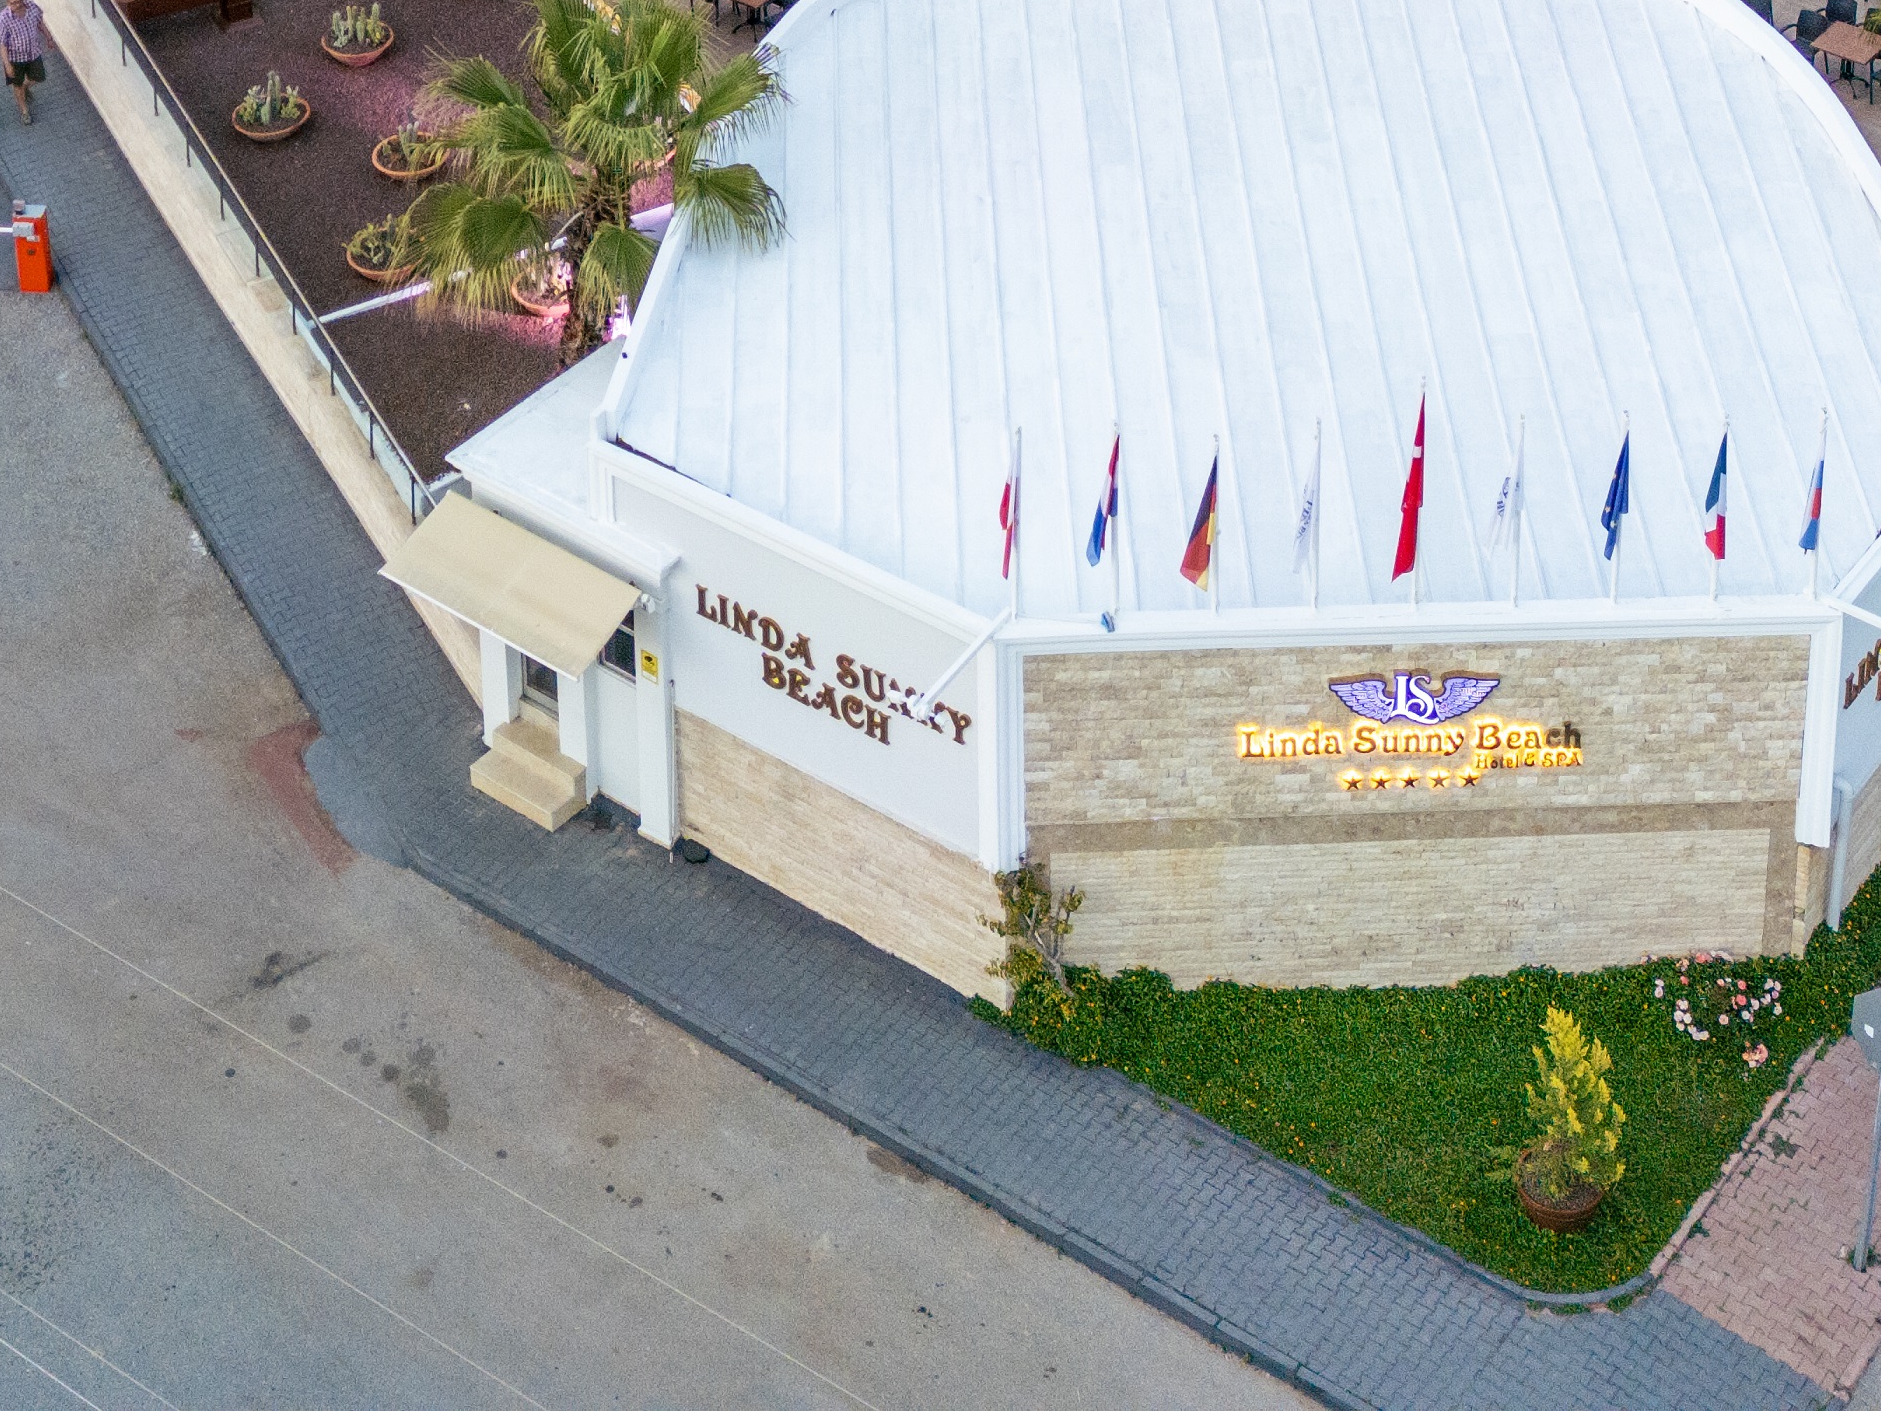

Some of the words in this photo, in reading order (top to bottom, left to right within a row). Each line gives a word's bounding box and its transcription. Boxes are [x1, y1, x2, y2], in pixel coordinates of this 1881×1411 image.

[695, 583, 815, 671] LINDA
[761, 651, 891, 746] BEACH
[1240, 722, 1342, 758] Linda
[1353, 726, 1465, 756] Sunny
[1476, 721, 1582, 750] Beach
[1476, 754, 1519, 769] Hotel
[1524, 752, 1535, 767] &
[1542, 752, 1581, 768] SPA
